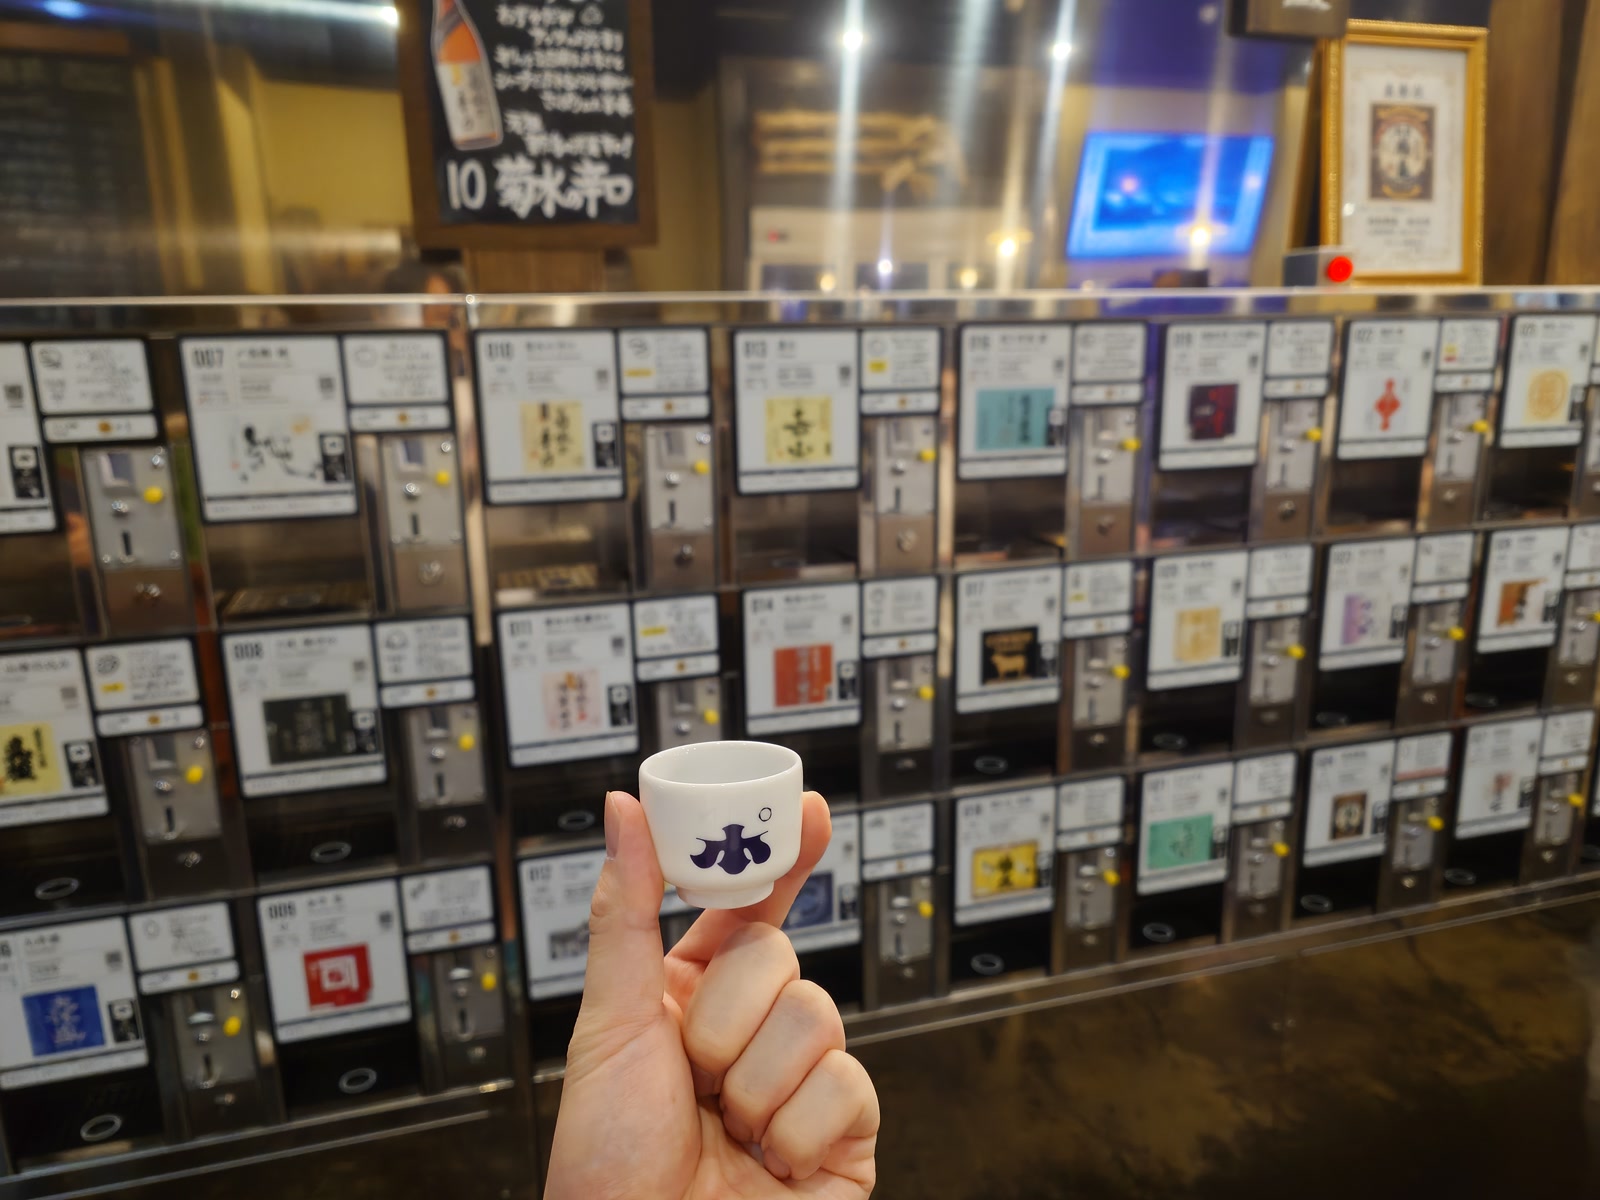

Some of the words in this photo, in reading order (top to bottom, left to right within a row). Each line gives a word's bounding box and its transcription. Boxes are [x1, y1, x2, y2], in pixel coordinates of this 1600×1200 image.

[447, 159, 487, 210] 10
[193, 346, 225, 368] 007
[233, 640, 265, 661] 008
